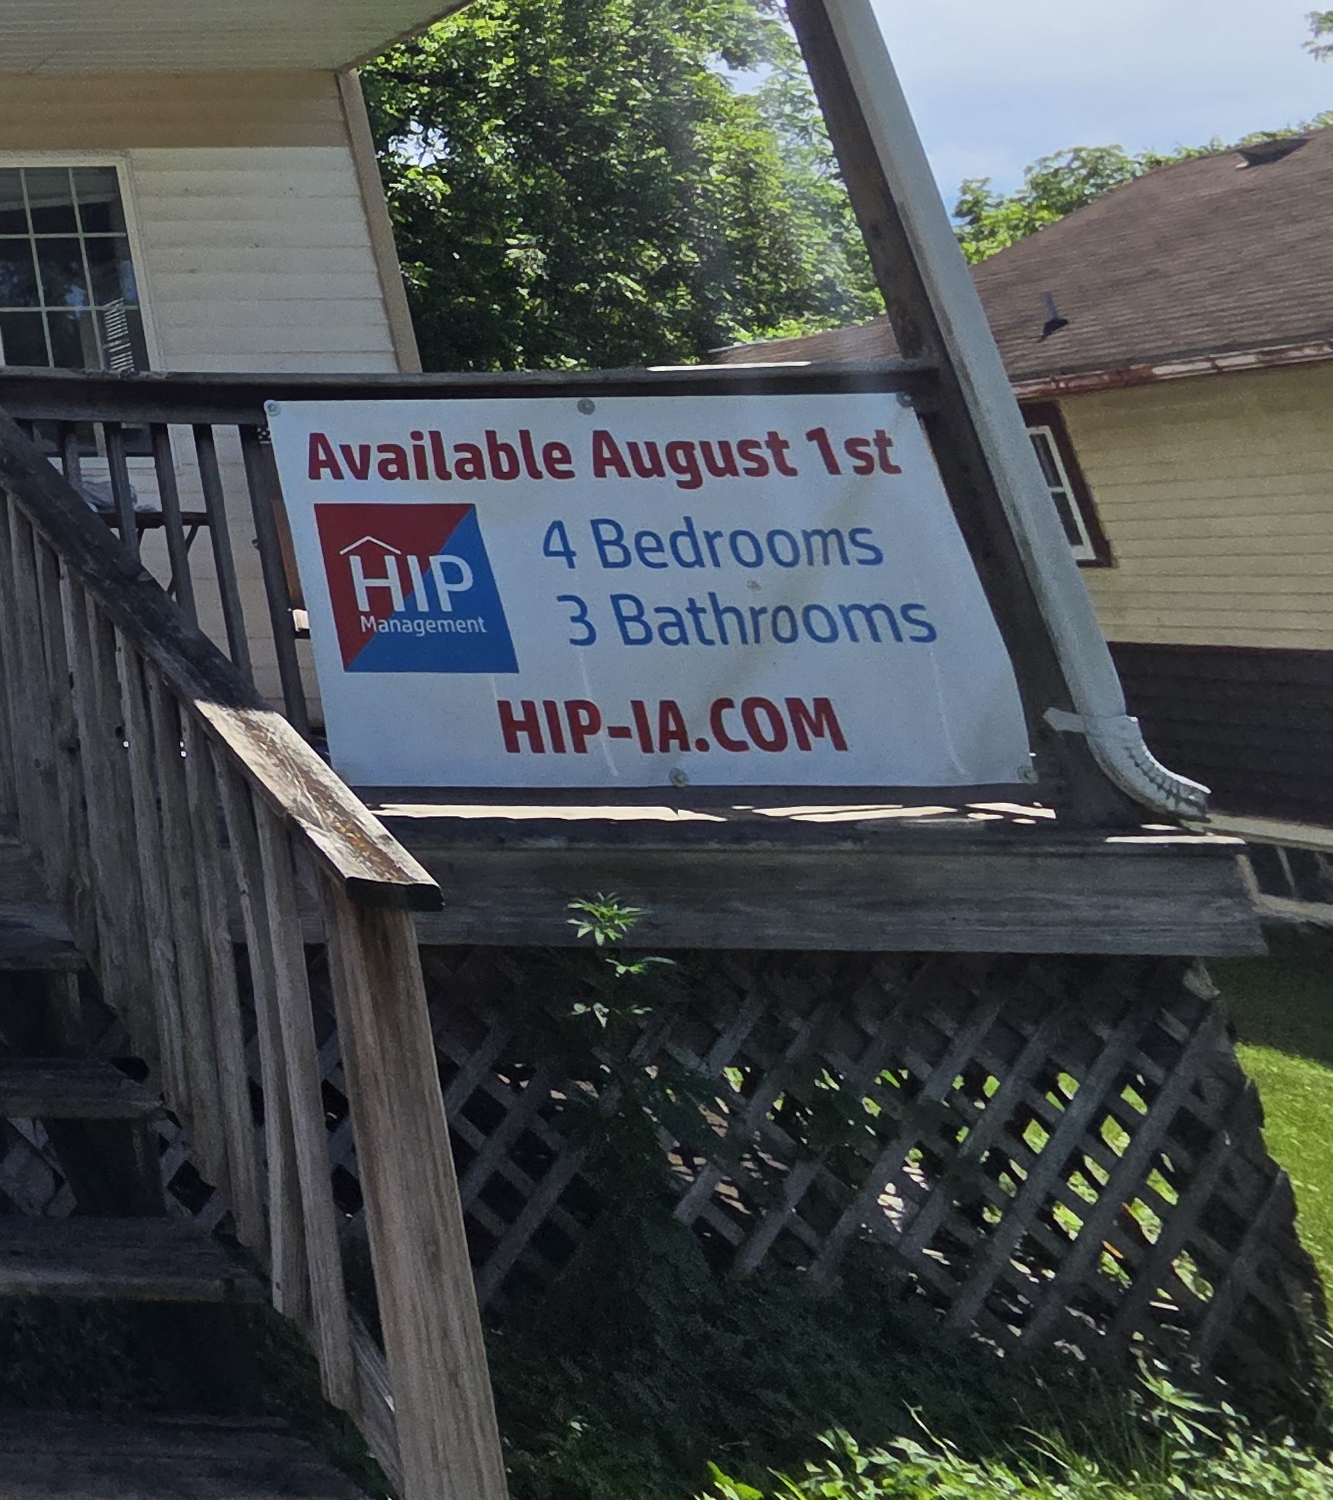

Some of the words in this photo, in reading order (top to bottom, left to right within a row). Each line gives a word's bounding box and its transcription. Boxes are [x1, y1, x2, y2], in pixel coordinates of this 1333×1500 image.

[308, 429, 576, 481] Available
[592, 429, 799, 490] August
[805, 427, 903, 476] 1st
[542, 519, 577, 569] 4
[589, 516, 885, 569] Bedrooms
[348, 554, 474, 613] HIP
[359, 614, 488, 637] Management
[556, 594, 597, 647] 3
[609, 591, 938, 647] Bathrooms
[497, 696, 850, 754] HIP-IA.COM
